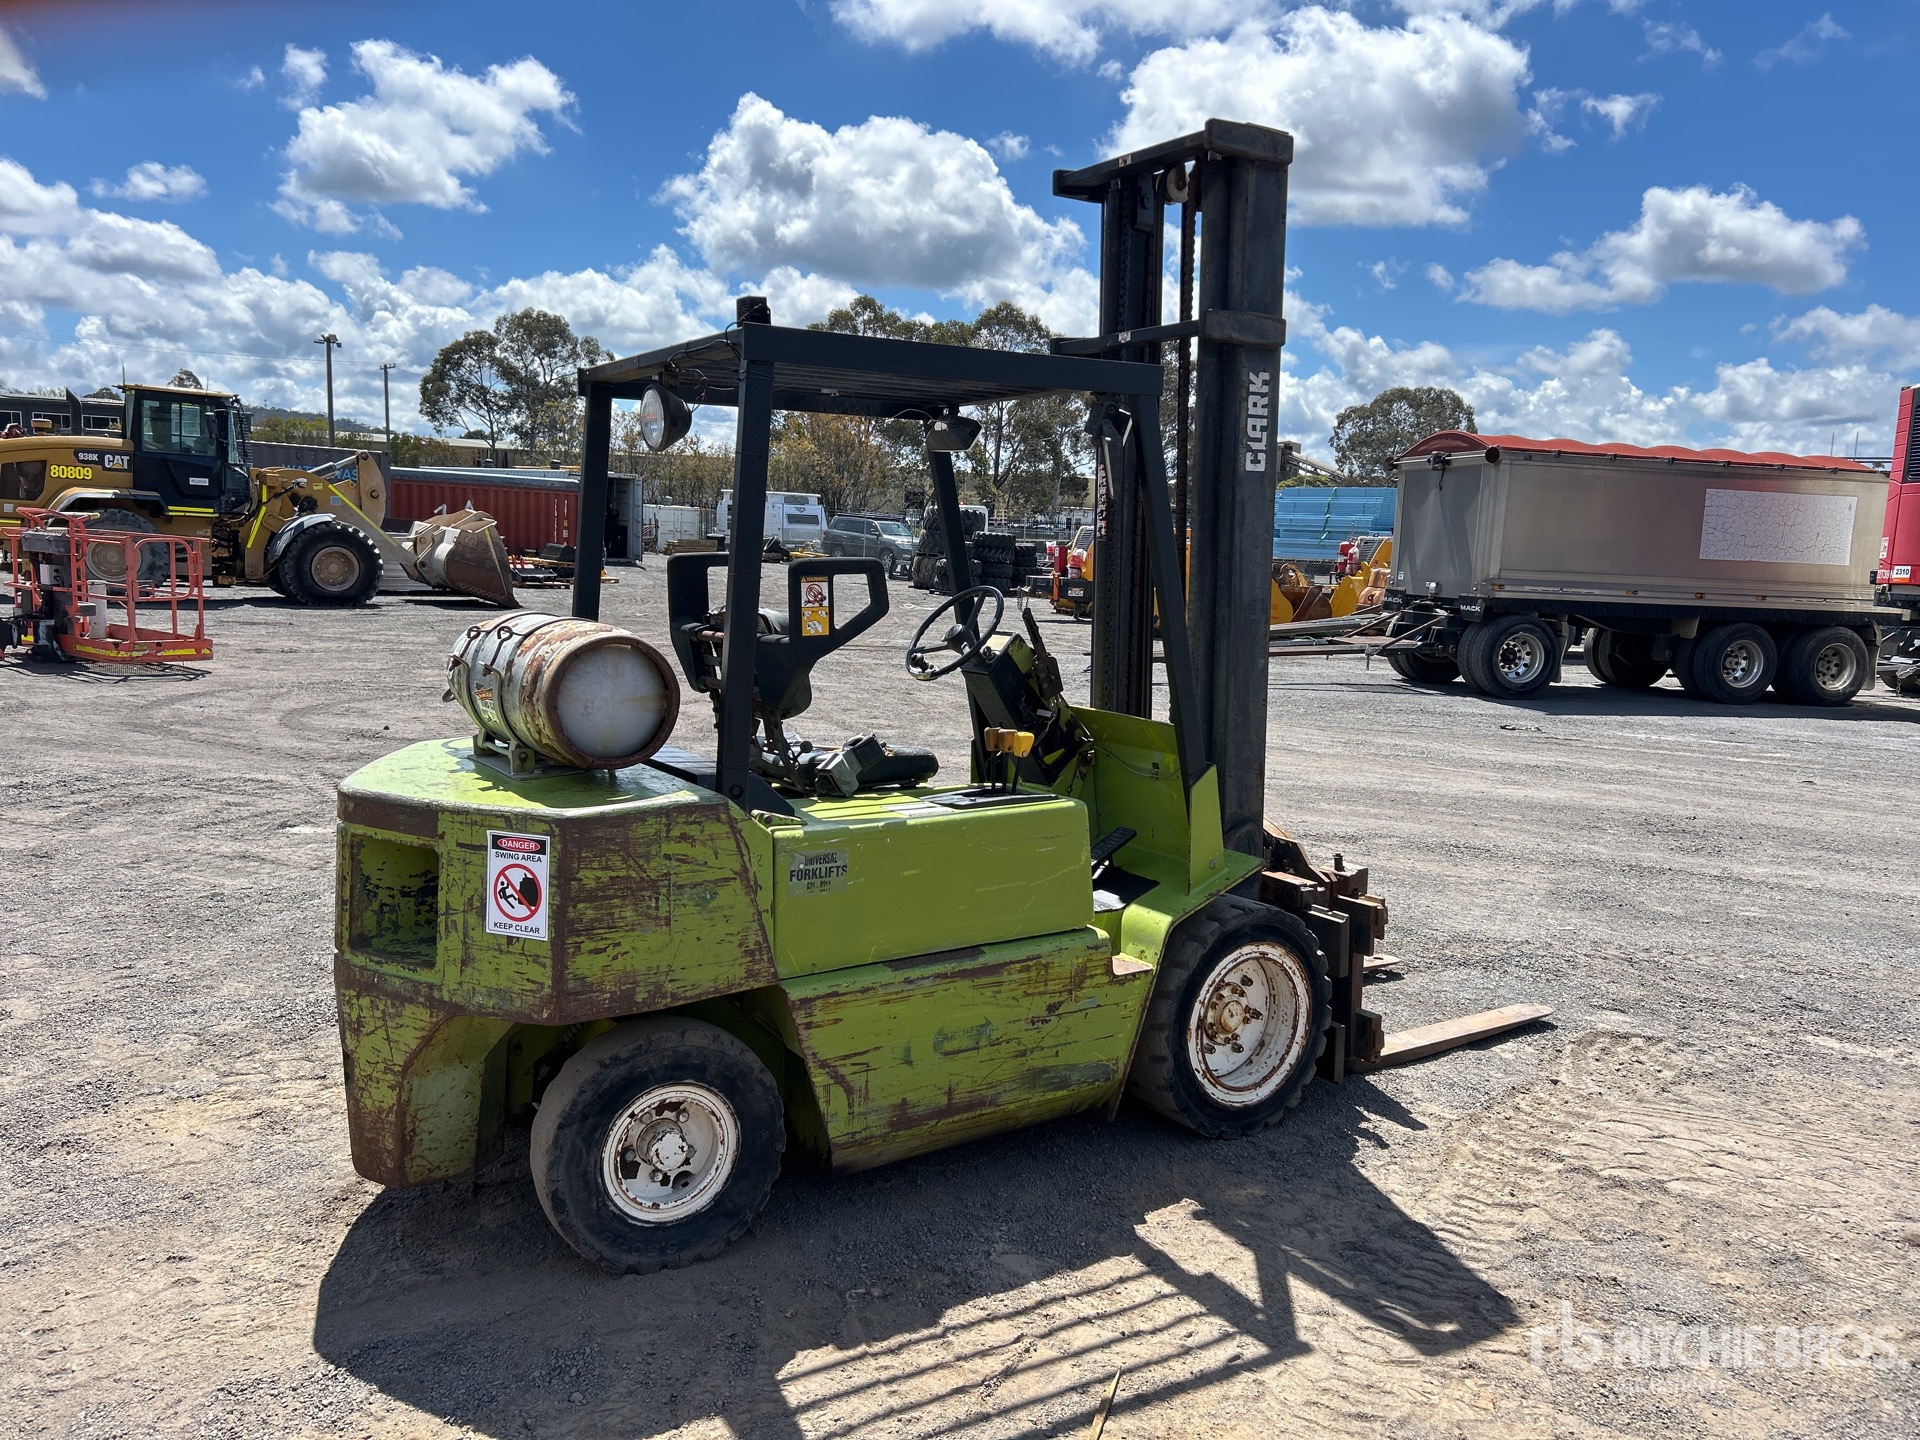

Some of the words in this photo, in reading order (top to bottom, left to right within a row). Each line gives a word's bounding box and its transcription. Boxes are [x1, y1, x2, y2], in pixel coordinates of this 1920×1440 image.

[1245, 371, 1270, 472] CLARK
[78, 452, 99, 462] 938K
[104, 454, 130, 470] CAT
[50, 464, 93, 480] 80809
[1895, 568, 1910, 576] 2310
[1460, 604, 1481, 613] MACK
[502, 839, 536, 851] DANGER
[494, 850, 520, 861] SWING
[520, 854, 542, 863] AREA
[789, 864, 848, 883] FORKLIFTS
[493, 921, 514, 931] KEEP
[514, 923, 540, 935] CLEAR
